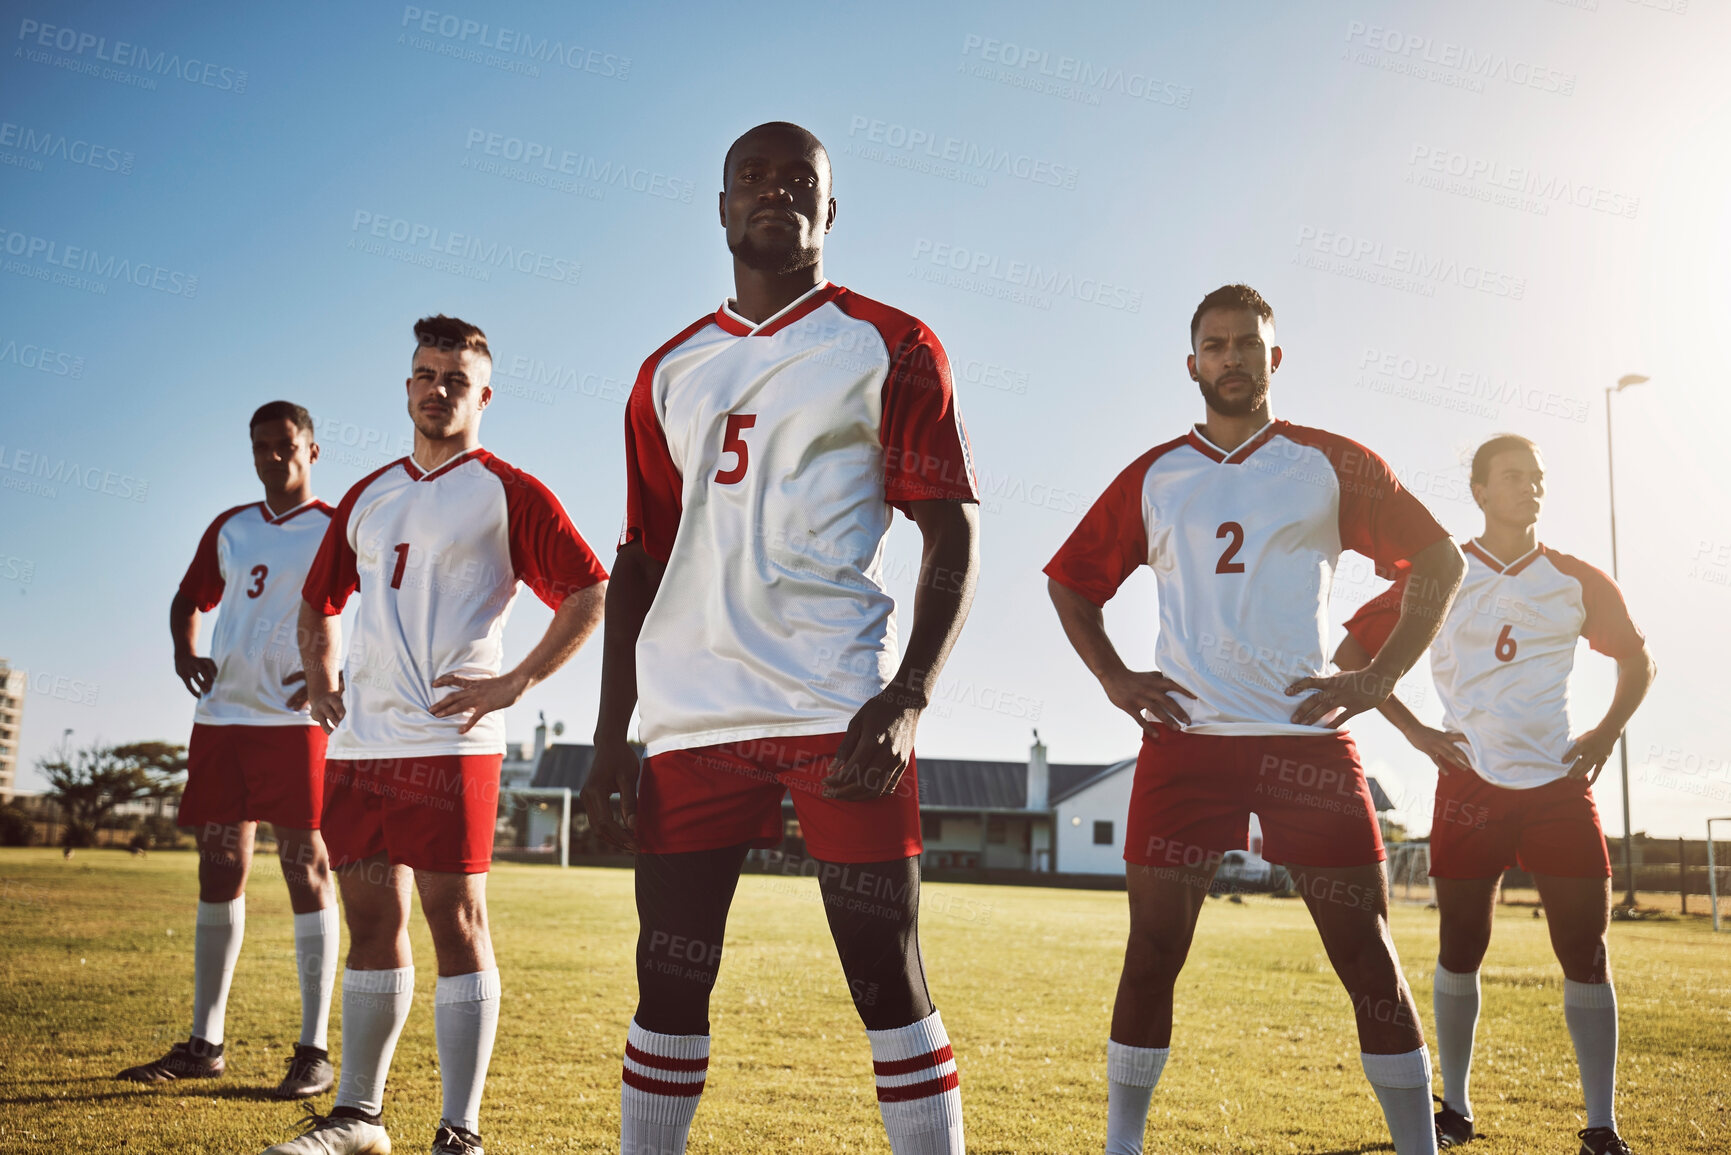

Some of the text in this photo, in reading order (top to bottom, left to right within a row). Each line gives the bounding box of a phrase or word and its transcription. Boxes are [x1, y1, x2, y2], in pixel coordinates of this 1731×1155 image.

[714, 414, 756, 484] 5
[390, 543, 409, 590] 1
[1215, 521, 1245, 574] 2
[247, 564, 268, 599] 3
[1495, 624, 1517, 662] 6
